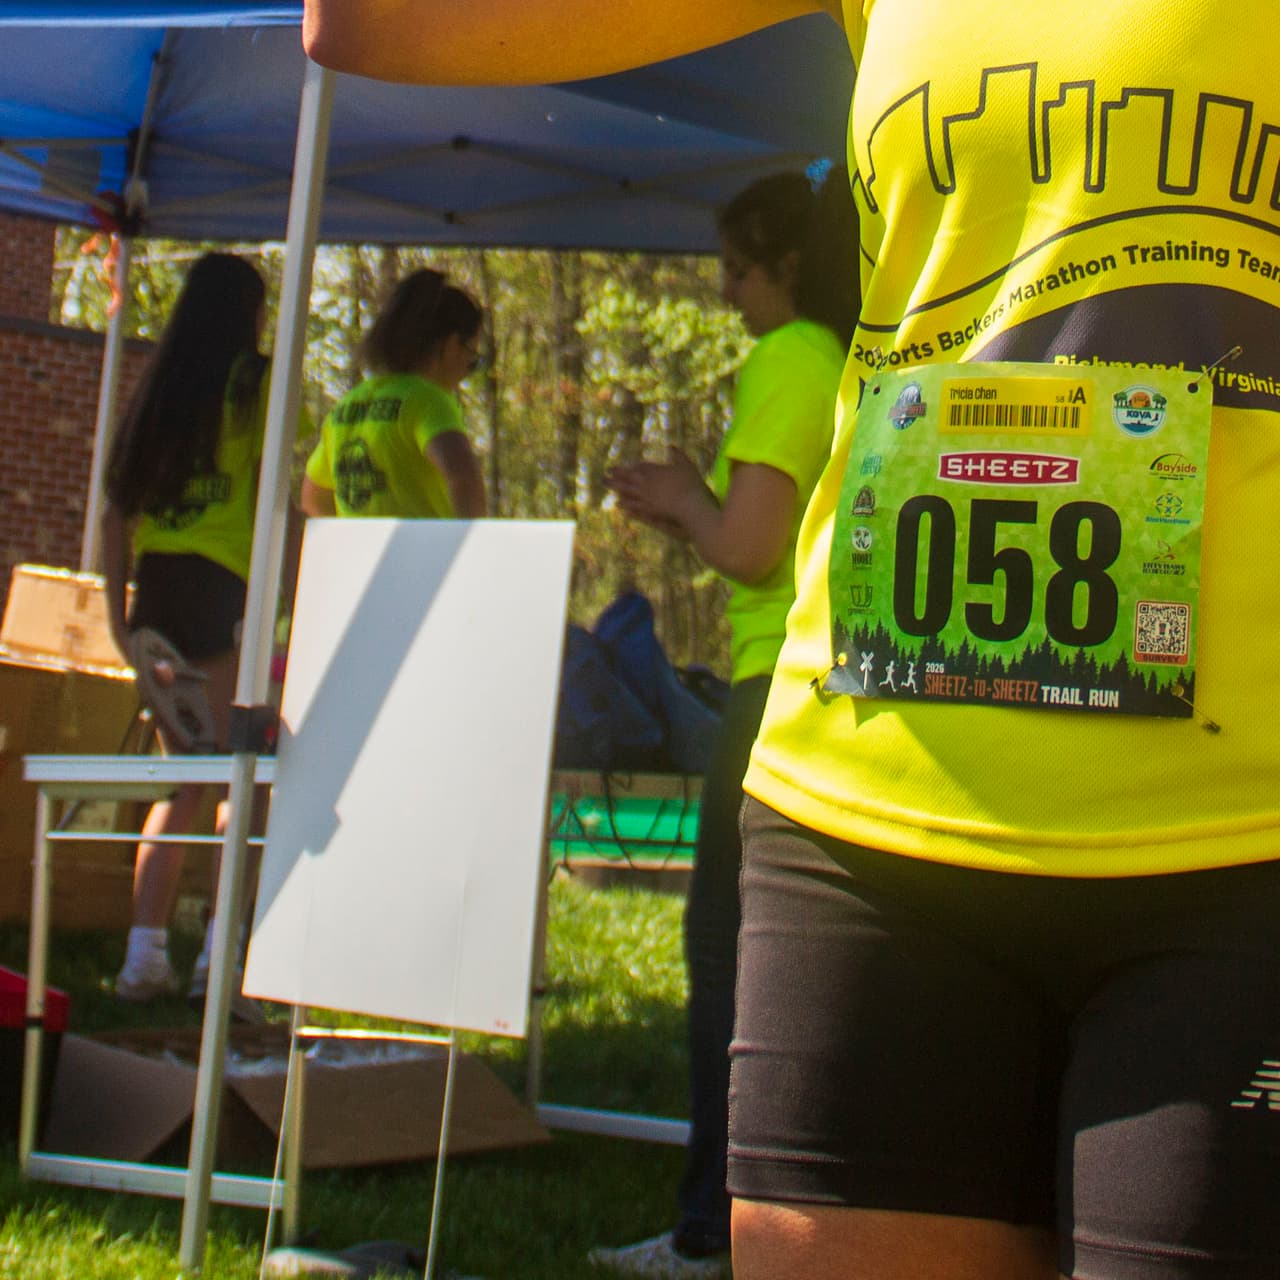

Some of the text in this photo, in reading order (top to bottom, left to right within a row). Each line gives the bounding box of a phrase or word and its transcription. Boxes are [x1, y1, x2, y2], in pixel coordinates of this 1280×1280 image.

[937, 304, 1005, 352] Backers
[1009, 254, 1117, 308] Marathon
[1122, 240, 1230, 268] Training
[950, 387, 997, 401] Tricia Chan
[947, 458, 1070, 480] SHEETZ
[1156, 462, 1197, 474] Bayside
[892, 494, 1122, 647] 058
[924, 673, 1120, 708] SHEETZ-TO-SHEETZ TRAIL RUN
